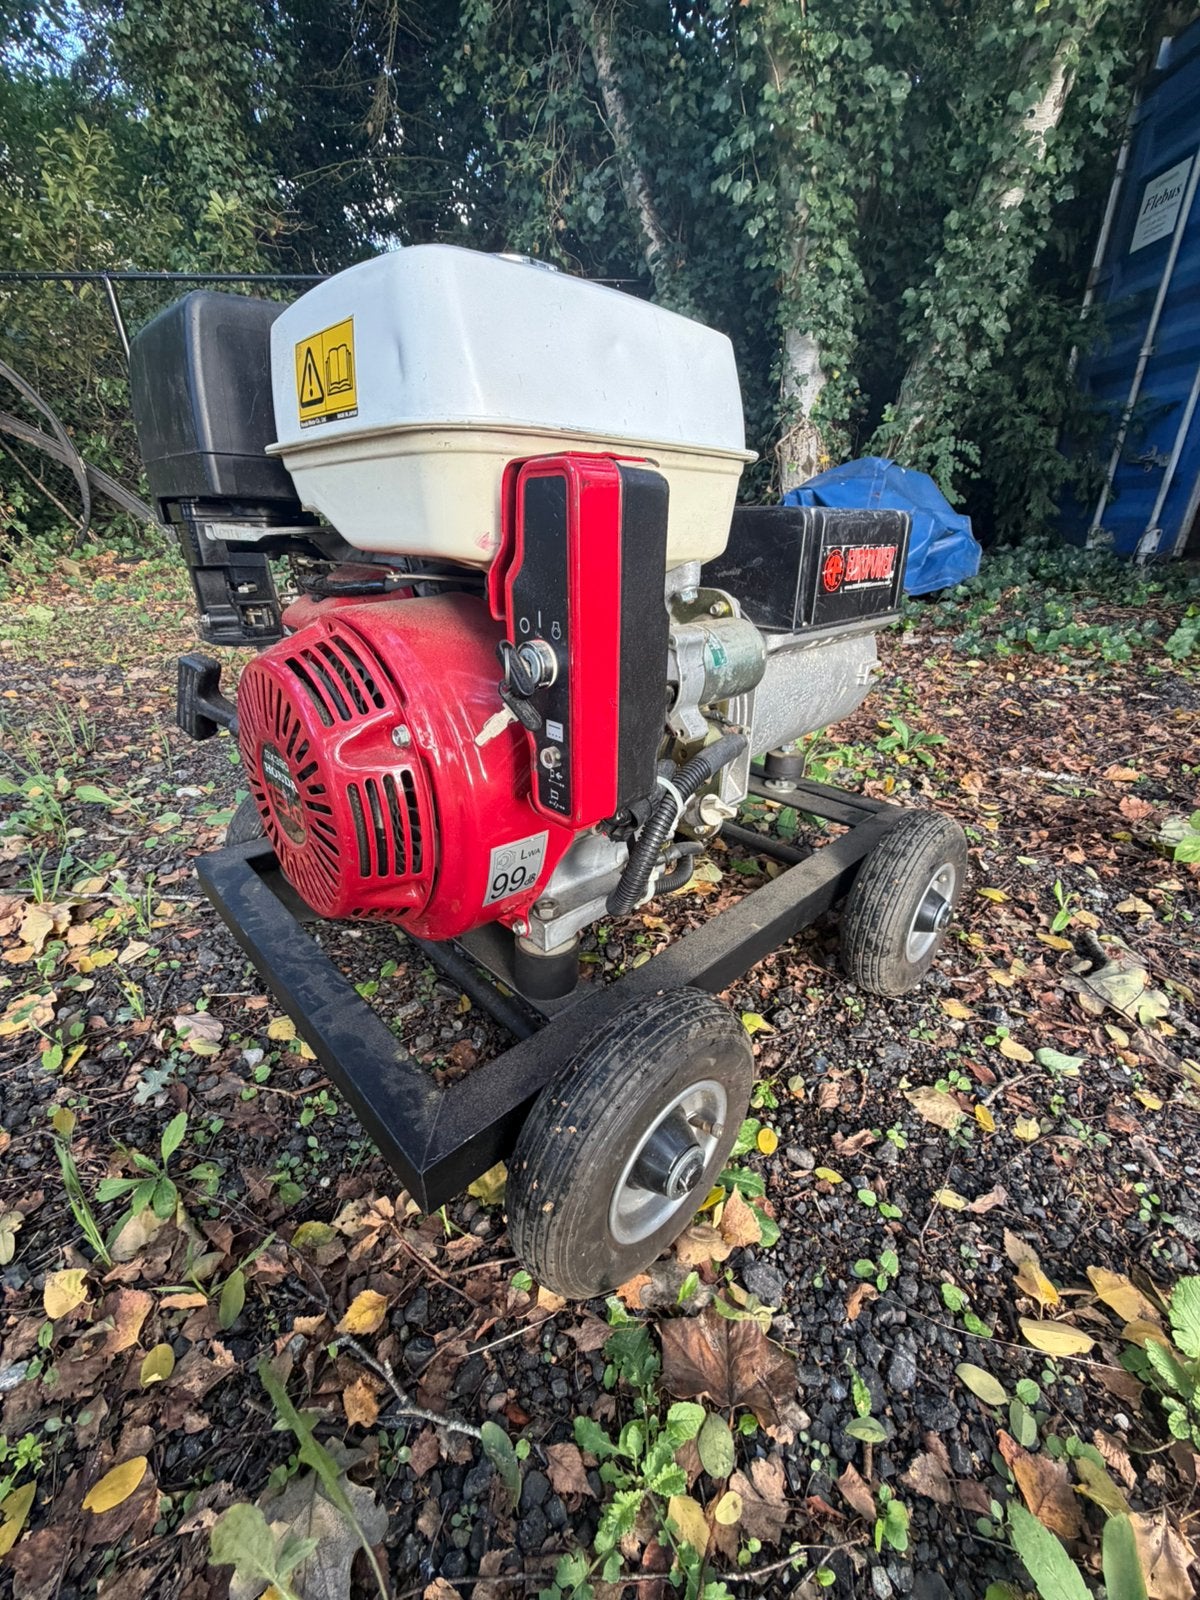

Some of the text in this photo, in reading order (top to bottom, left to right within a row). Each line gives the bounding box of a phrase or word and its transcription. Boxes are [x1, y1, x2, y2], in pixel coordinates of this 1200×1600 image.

[1142, 183, 1182, 216] Flebus
[263, 761, 300, 794] HONDA
[491, 866, 527, 899] 99
